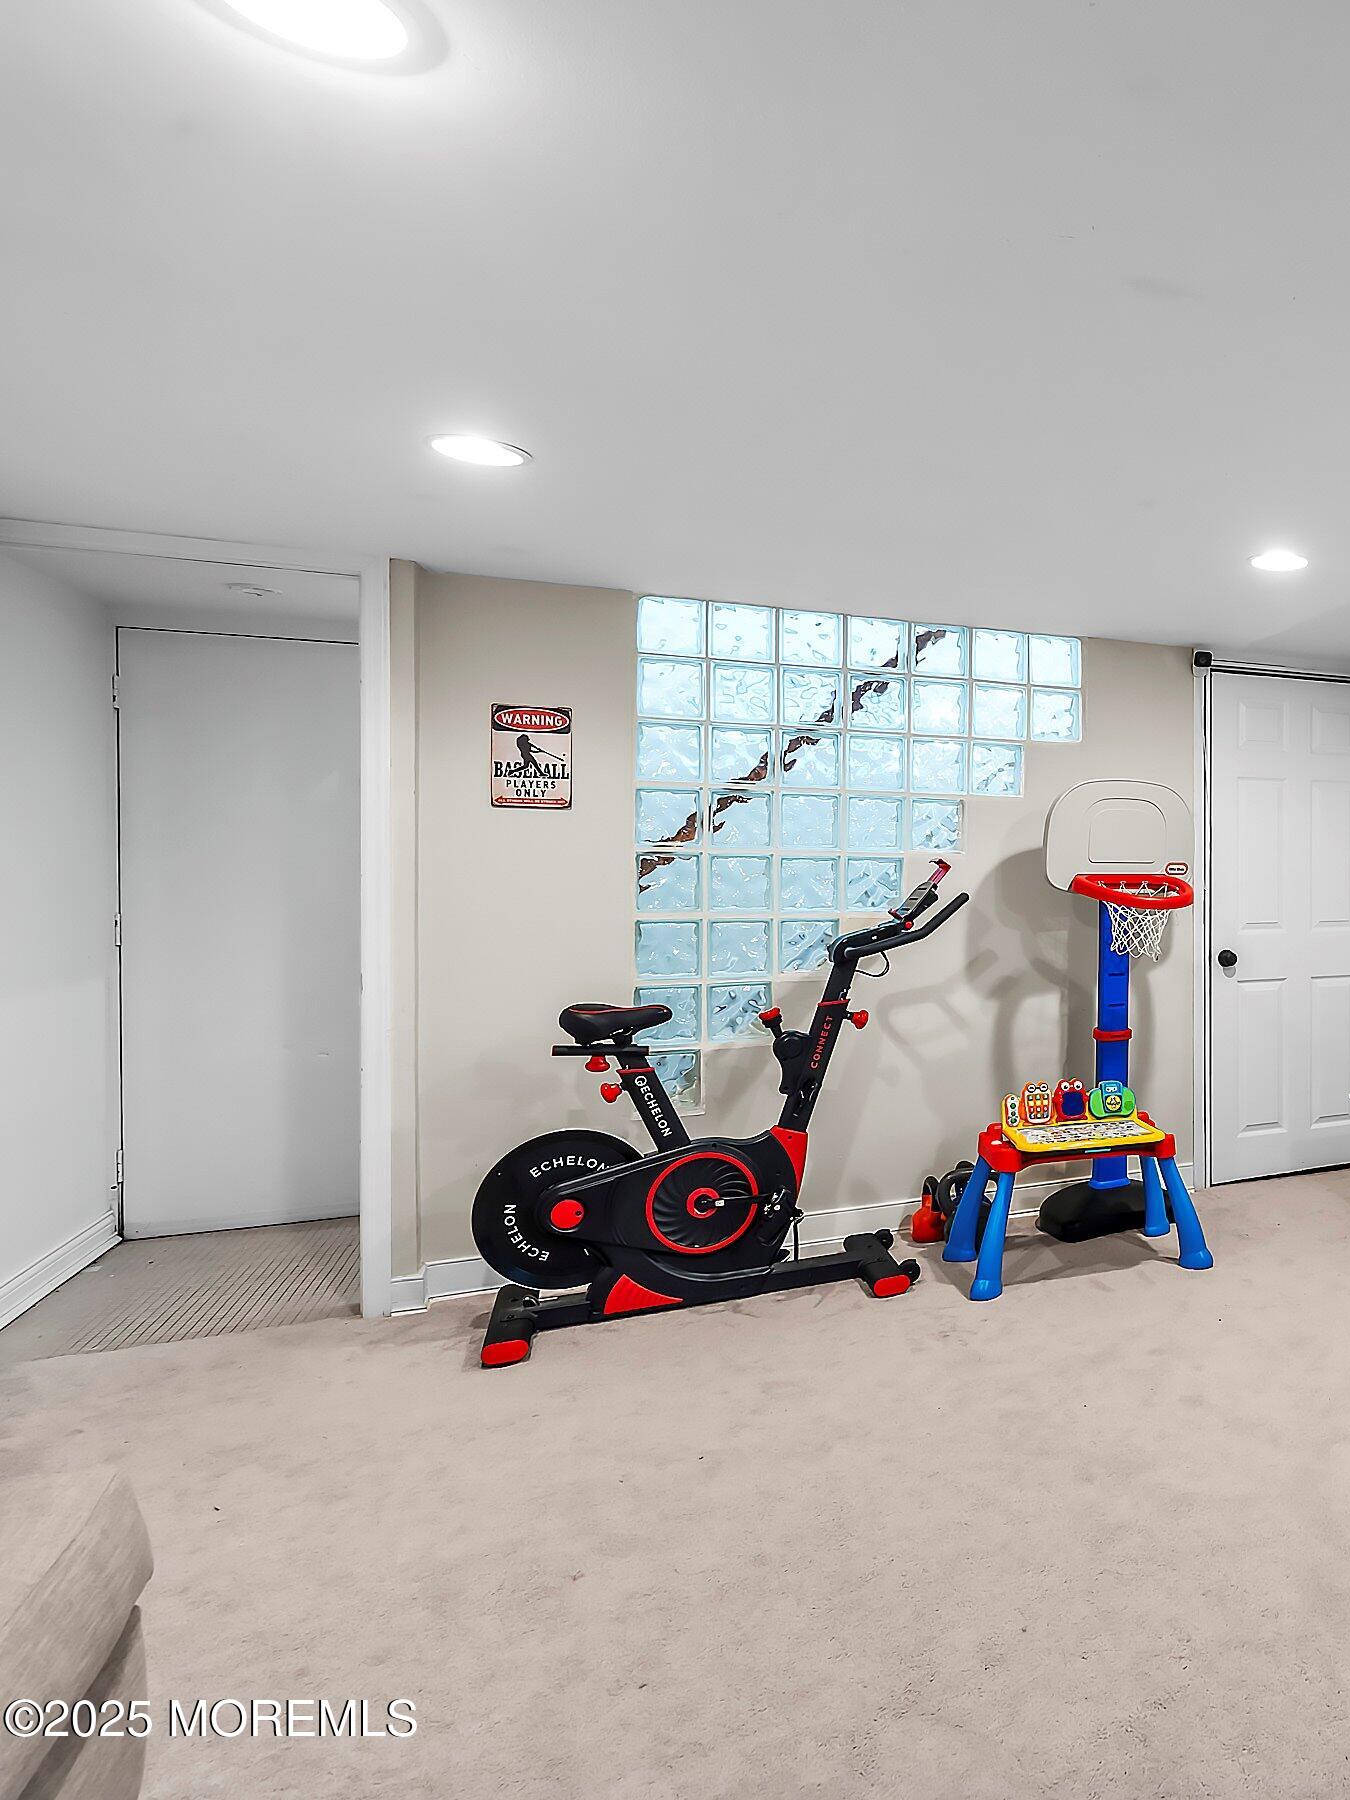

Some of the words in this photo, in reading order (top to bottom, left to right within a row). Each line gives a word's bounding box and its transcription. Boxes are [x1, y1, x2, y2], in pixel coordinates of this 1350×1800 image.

[501, 713, 563, 727] WARNING
[506, 780, 556, 789] PLAYERS
[515, 789, 547, 797] ONLY
[810, 1015, 833, 1069] CONNECT
[639, 1085, 673, 1138] ECHELON
[503, 1204, 550, 1262] ECHELON
